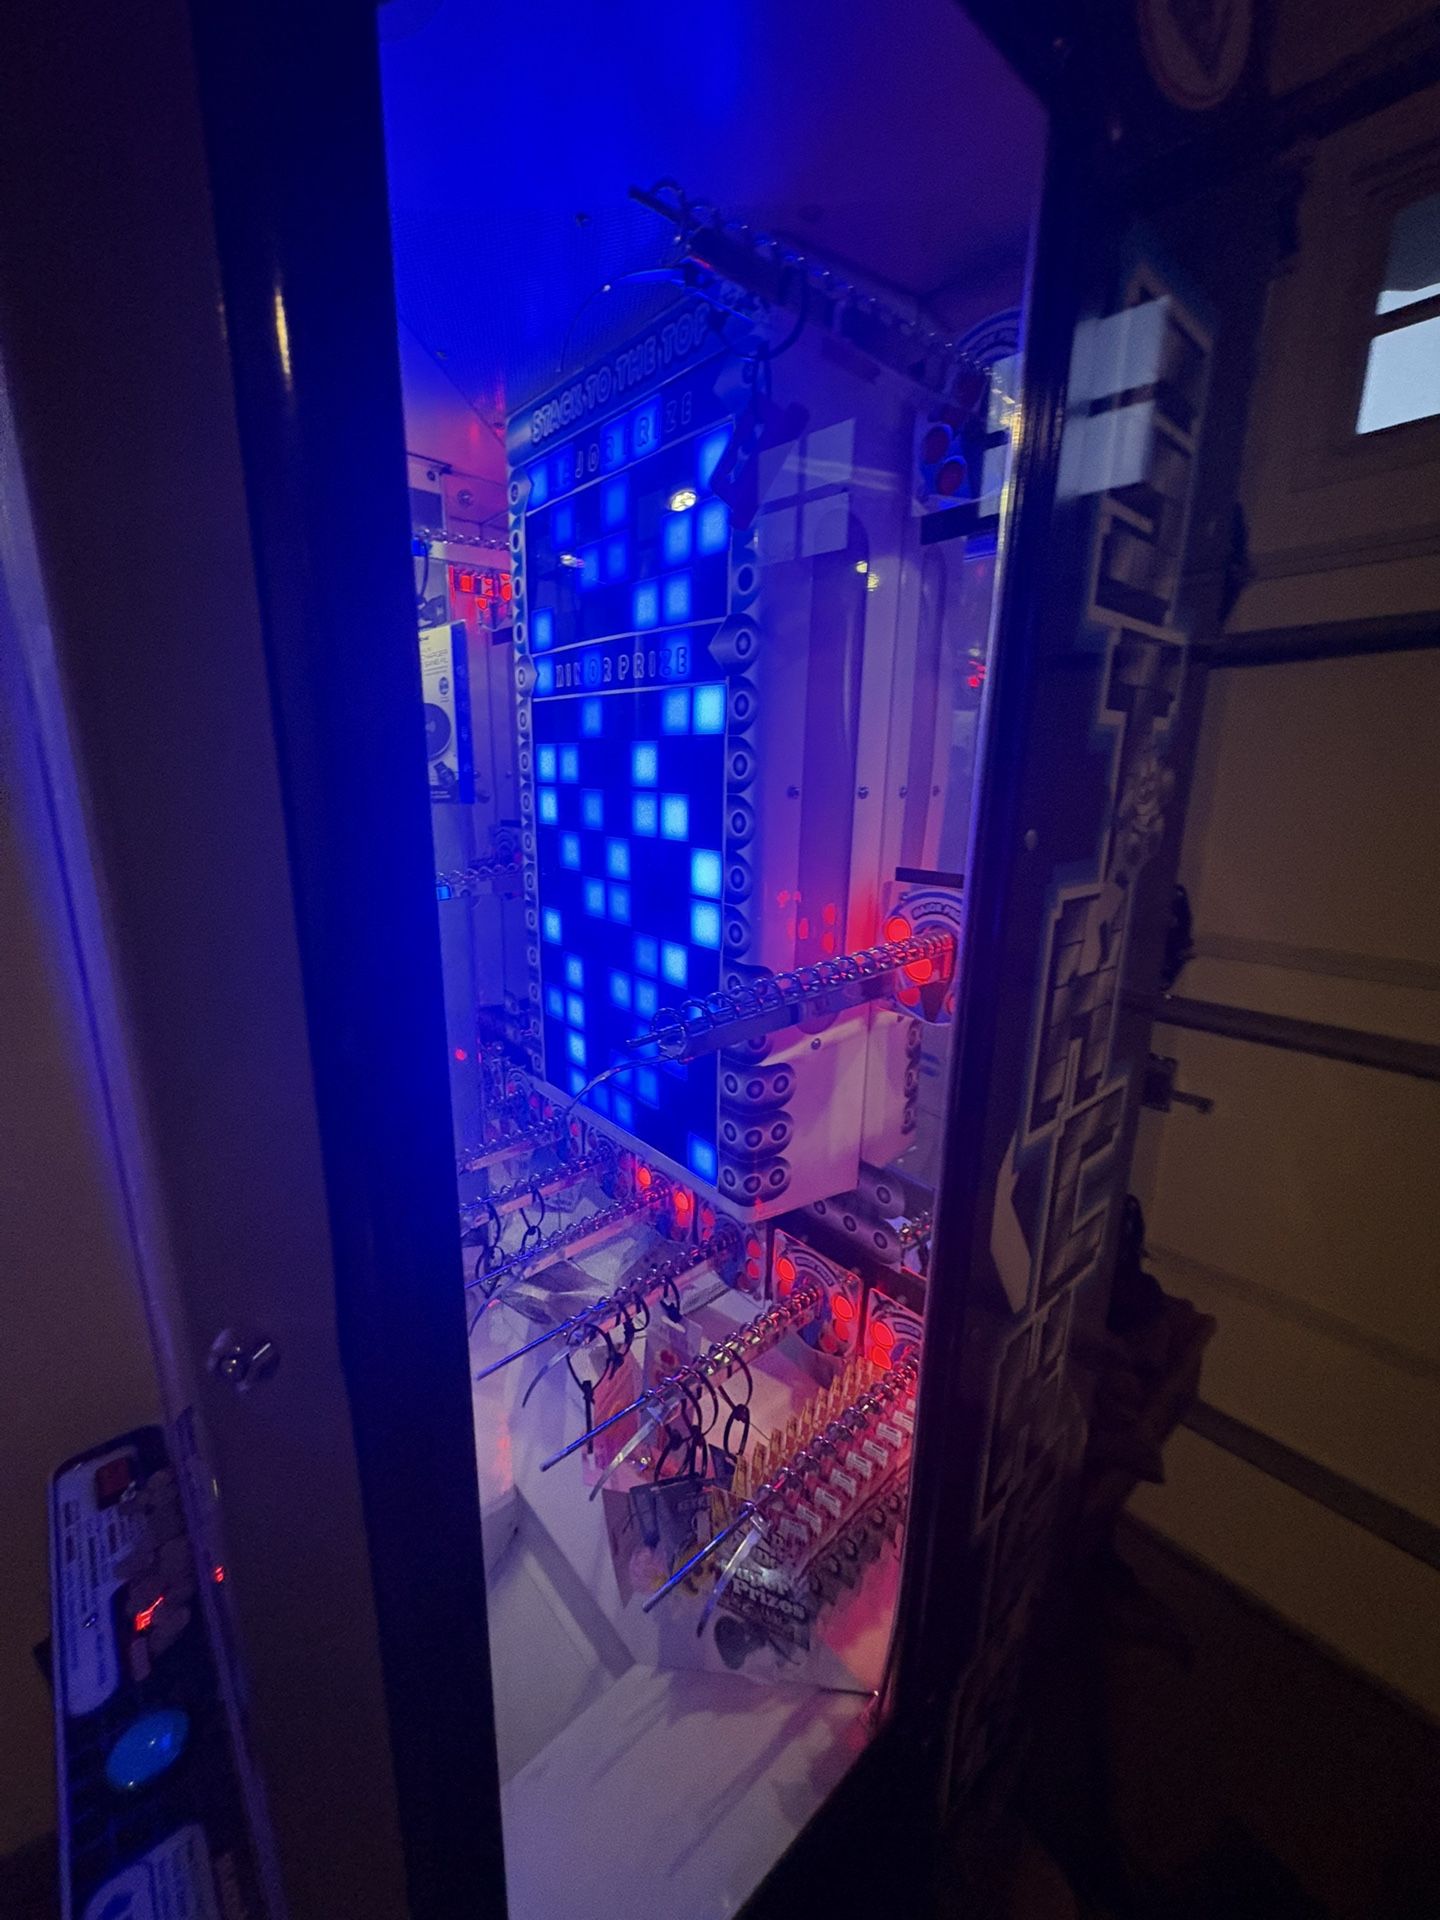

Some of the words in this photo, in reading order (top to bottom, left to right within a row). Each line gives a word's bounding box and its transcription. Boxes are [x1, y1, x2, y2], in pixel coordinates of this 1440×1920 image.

[531, 382, 584, 443] STACK
[585, 365, 612, 411] TO
[615, 336, 656, 393] THE
[661, 302, 711, 365] TOP
[617, 645, 689, 681] PRIZE
